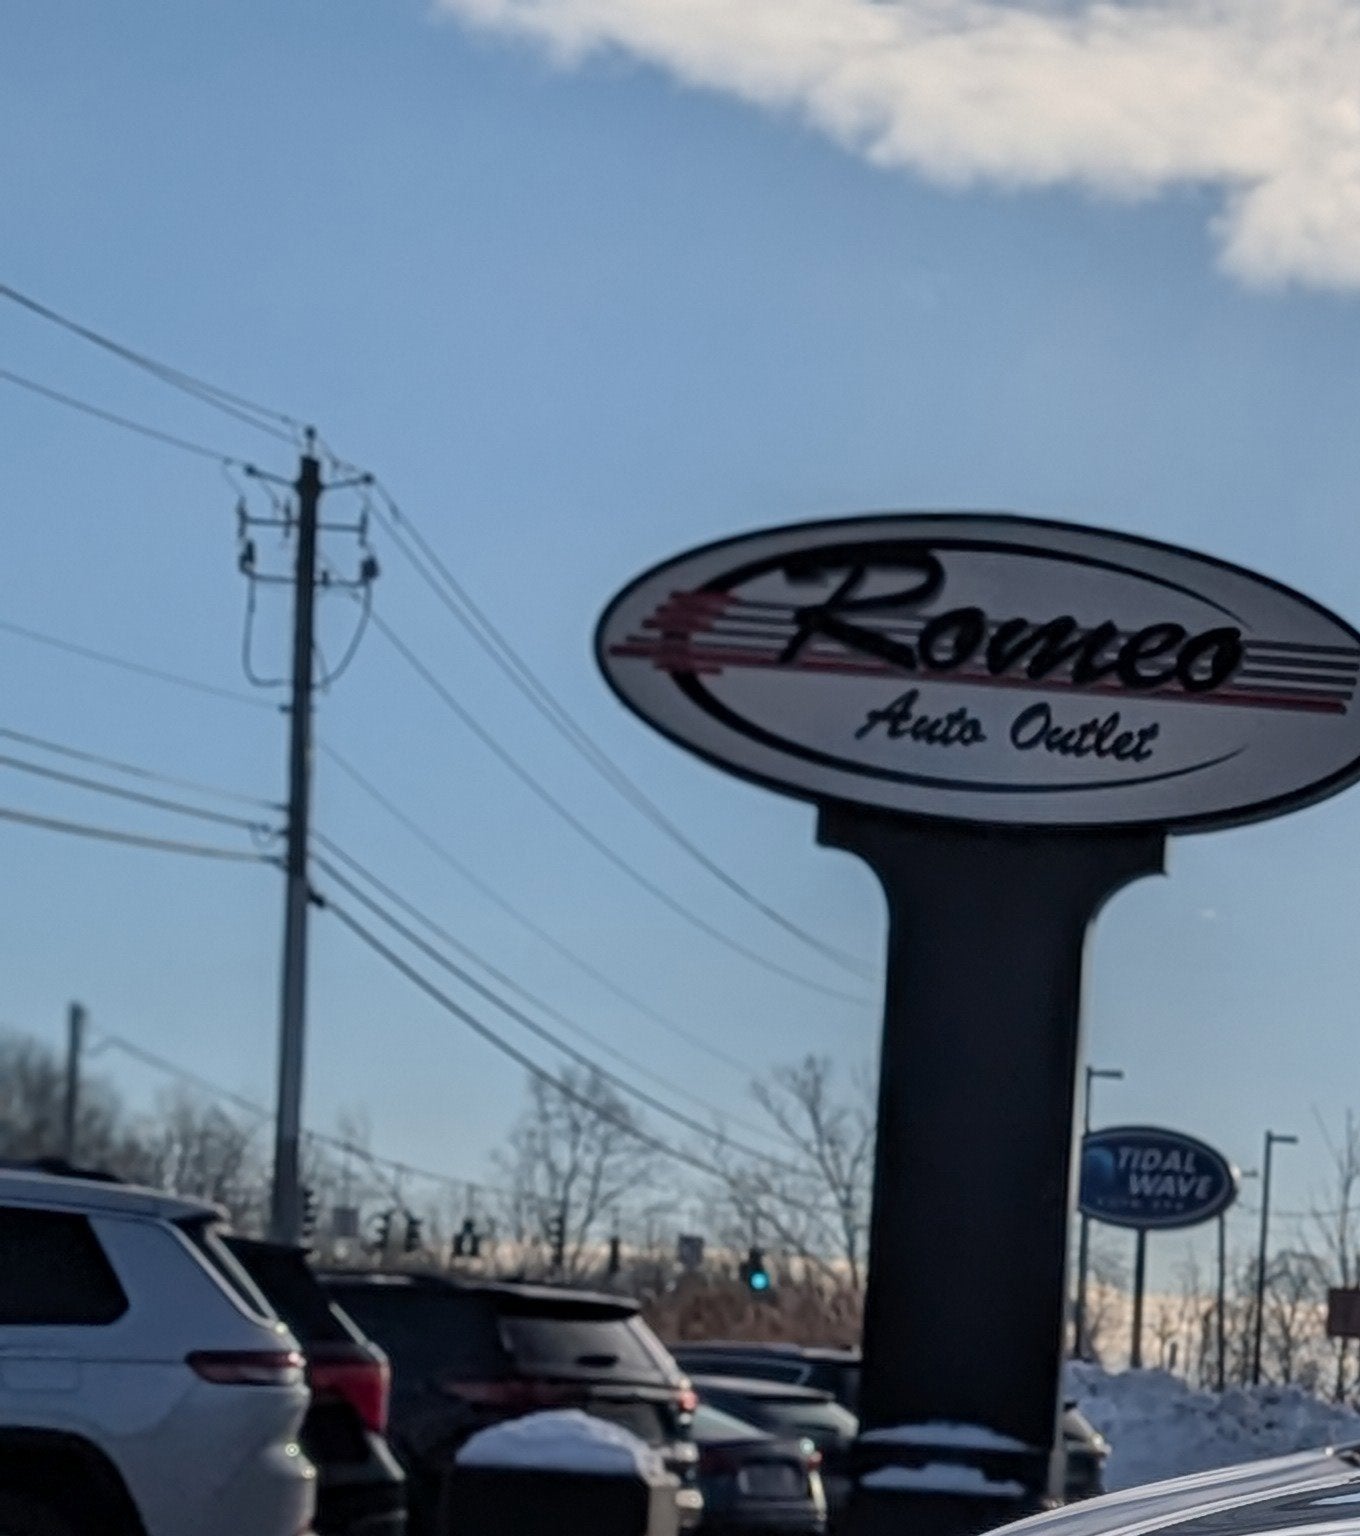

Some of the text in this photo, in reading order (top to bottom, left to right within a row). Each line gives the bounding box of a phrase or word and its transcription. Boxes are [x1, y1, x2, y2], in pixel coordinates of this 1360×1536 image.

[779, 548, 1243, 693] Romeo
[854, 688, 1160, 762] Auto Outlet
[1118, 1147, 1197, 1173] TIDAL
[1128, 1174, 1212, 1199] WAVE
